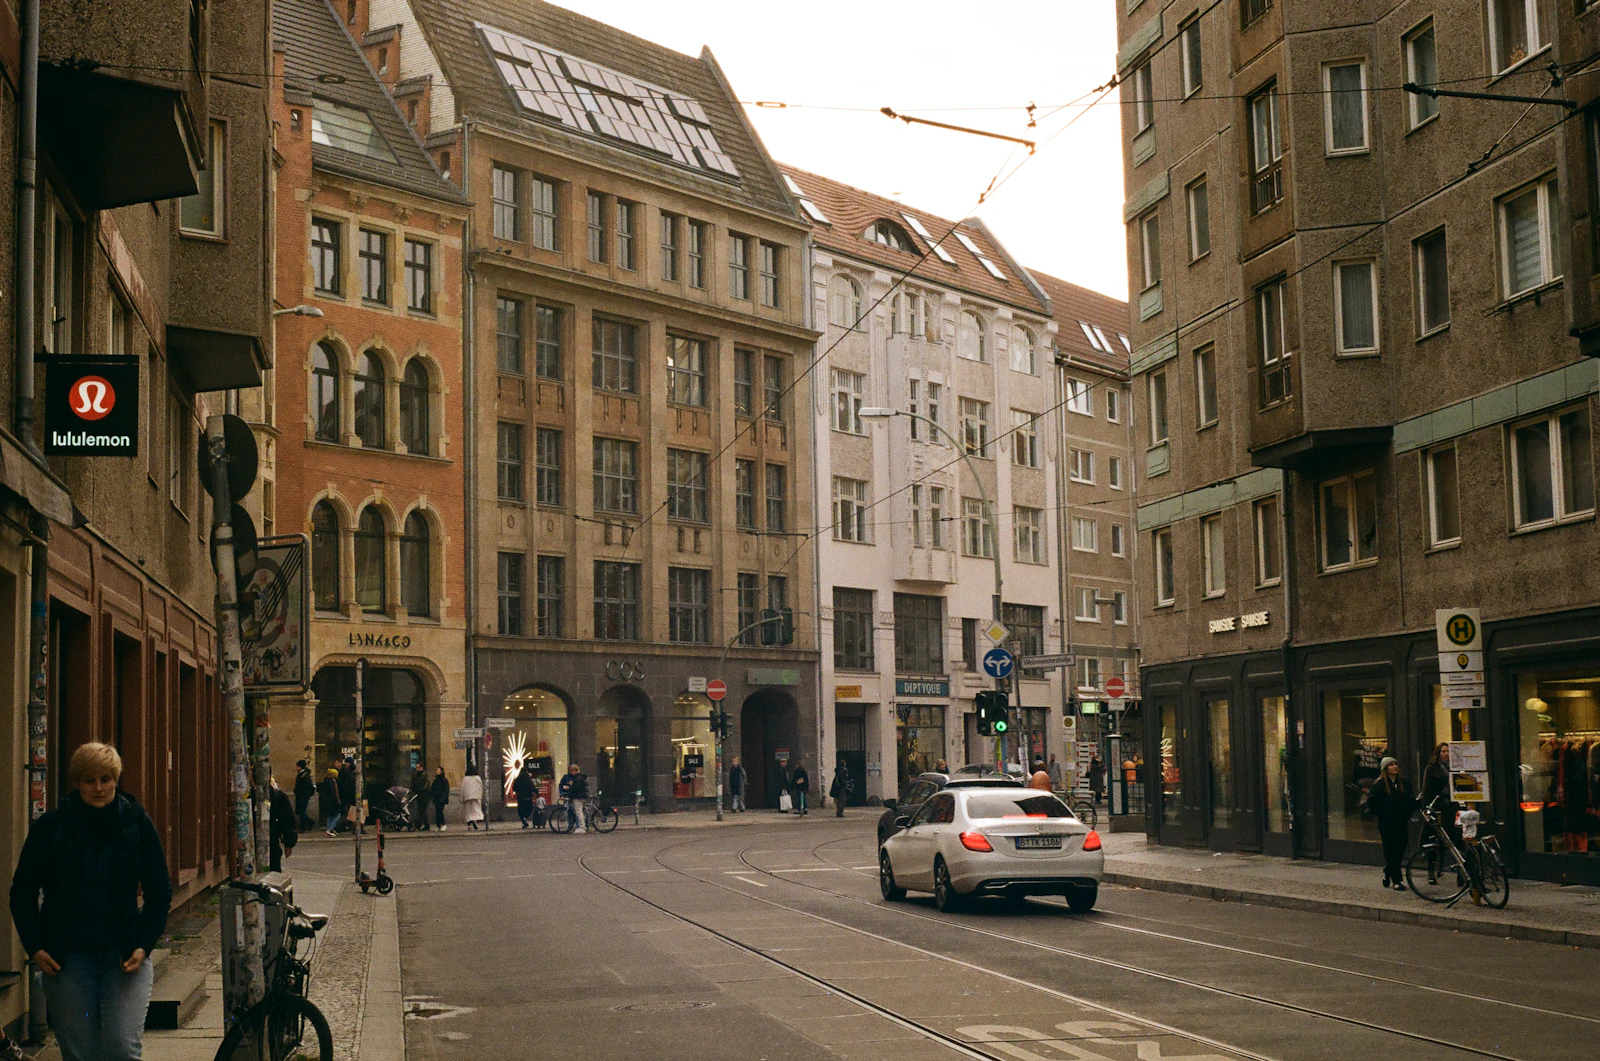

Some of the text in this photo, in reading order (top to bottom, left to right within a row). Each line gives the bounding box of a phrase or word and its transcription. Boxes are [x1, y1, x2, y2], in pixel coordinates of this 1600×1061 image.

[52, 431, 130, 447] lululemon
[1454, 621, 1469, 639] H
[605, 660, 645, 681] COS
[904, 682, 941, 694] DIPTYQUE
